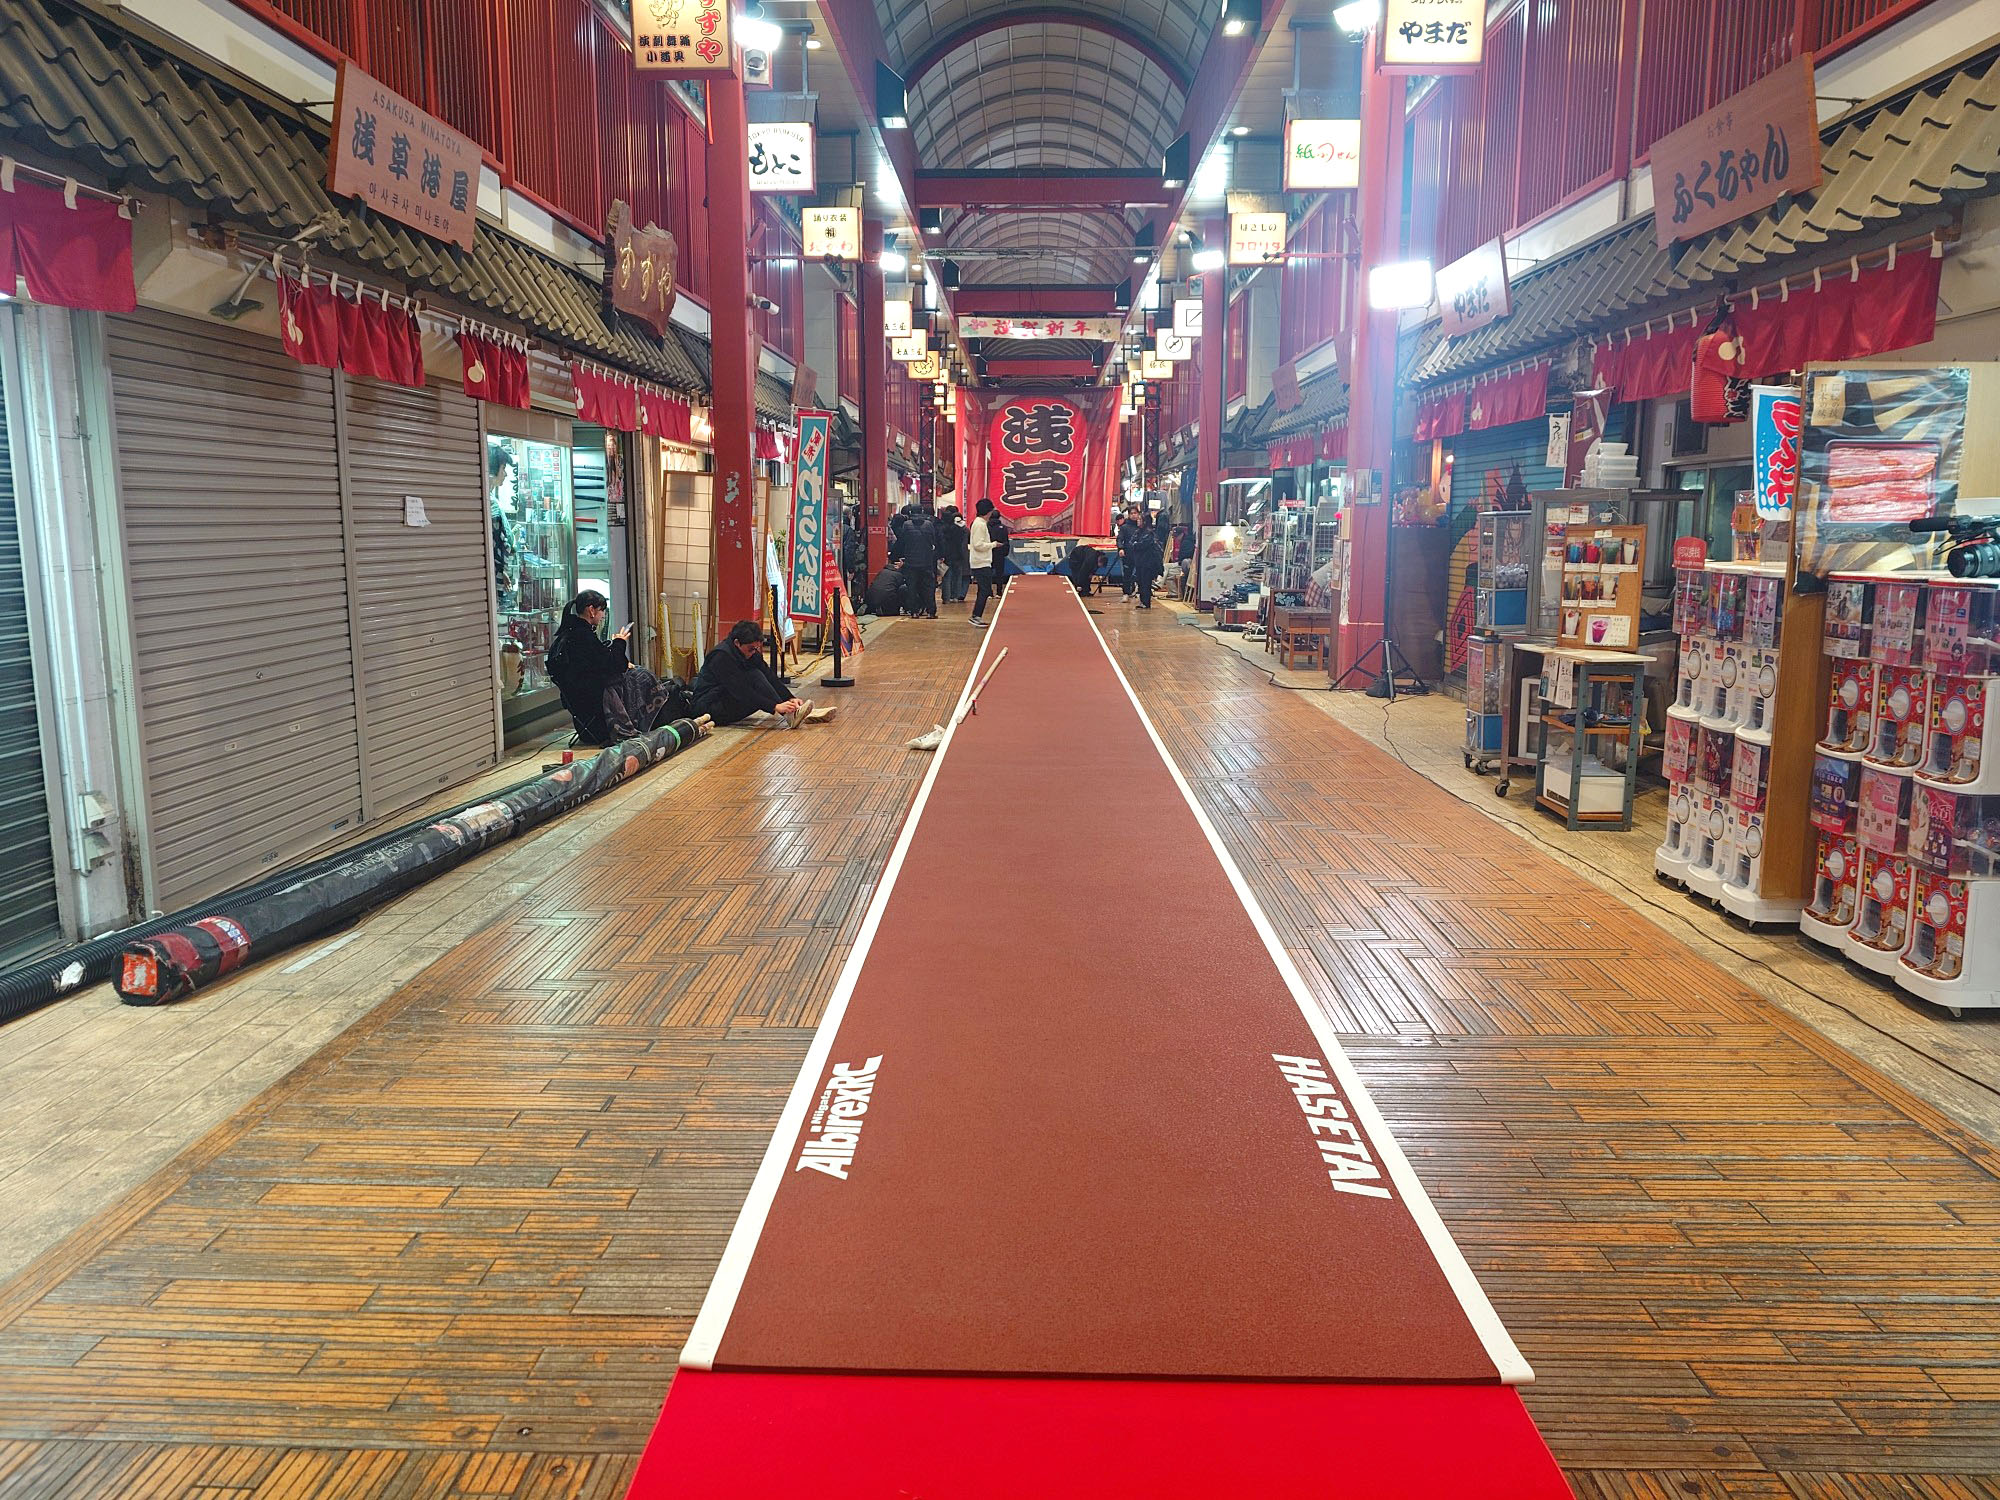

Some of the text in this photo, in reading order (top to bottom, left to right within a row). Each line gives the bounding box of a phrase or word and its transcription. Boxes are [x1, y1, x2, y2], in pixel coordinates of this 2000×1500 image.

[646, 51, 685, 63] 小道具
[1399, 20, 1472, 45] やまだ
[372, 89, 463, 157] ASAKUSA MINATOYA
[748, 142, 802, 176] もとこ
[369, 181, 450, 235] 아사쿠사 미나토야
[1000, 403, 1075, 510] 浅草
[1271, 1053, 1394, 1200] HASETAI
